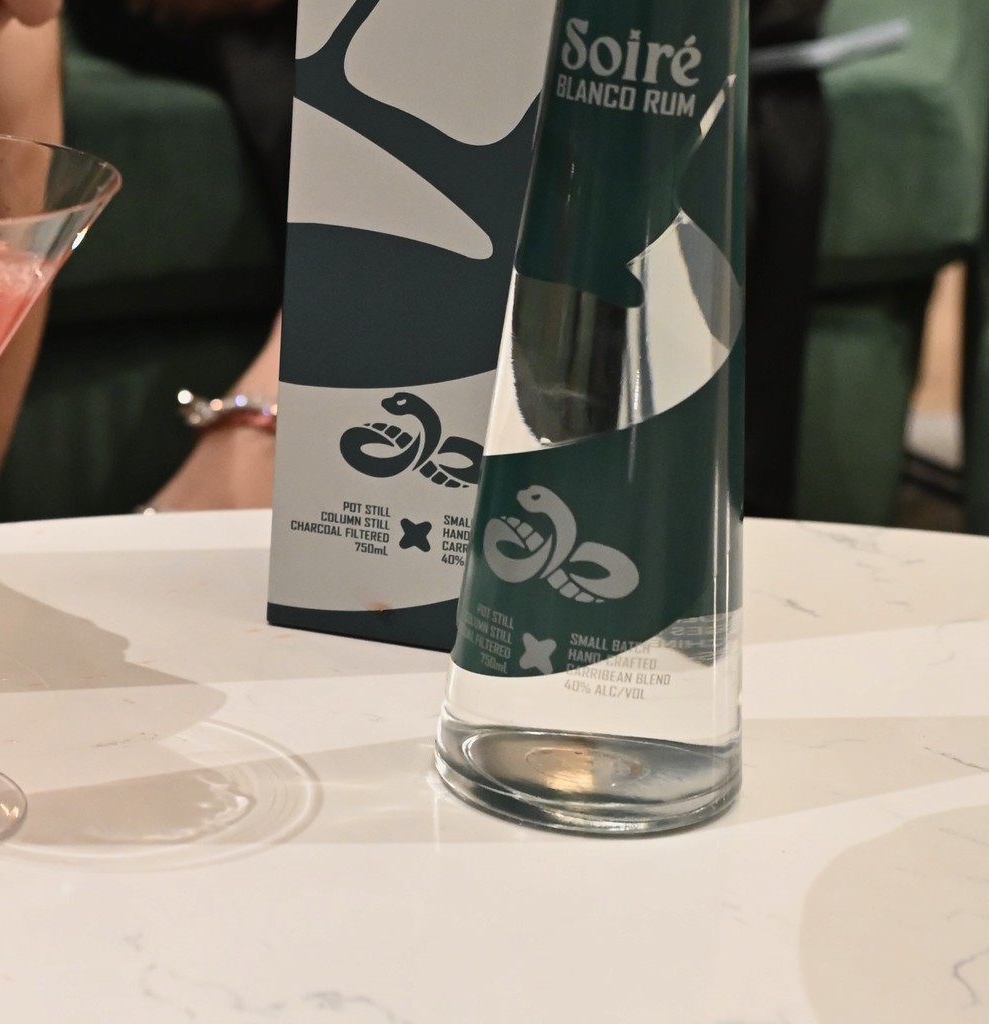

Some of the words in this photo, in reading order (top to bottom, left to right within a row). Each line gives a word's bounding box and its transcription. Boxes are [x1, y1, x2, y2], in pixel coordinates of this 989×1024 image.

[562, 17, 702, 87] Soiré
[556, 73, 637, 111] BLANCO
[643, 89, 696, 118] RUM
[343, 501, 362, 513] POT
[365, 504, 391, 517] STILL
[321, 511, 361, 526] COLUMN
[364, 517, 390, 530] STILL
[443, 515, 471, 528] SMAL
[290, 519, 342, 537] CHARCOAL
[345, 528, 390, 544] FILTERED
[354, 542, 388, 556] 750mL
[441, 554, 465, 566] 40%
[492, 610, 515, 630] STILL
[490, 626, 513, 646] STILL
[570, 632, 609, 651] SMALL
[476, 634, 512, 660] FILTERED
[568, 648, 602, 664] HAND
[480, 652, 509, 674] 750mL
[566, 664, 632, 683] CARRIBEAN
[635, 673, 671, 685] BLEND
[565, 679, 591, 694] 40%
[595, 684, 645, 700] ALC/VOL
